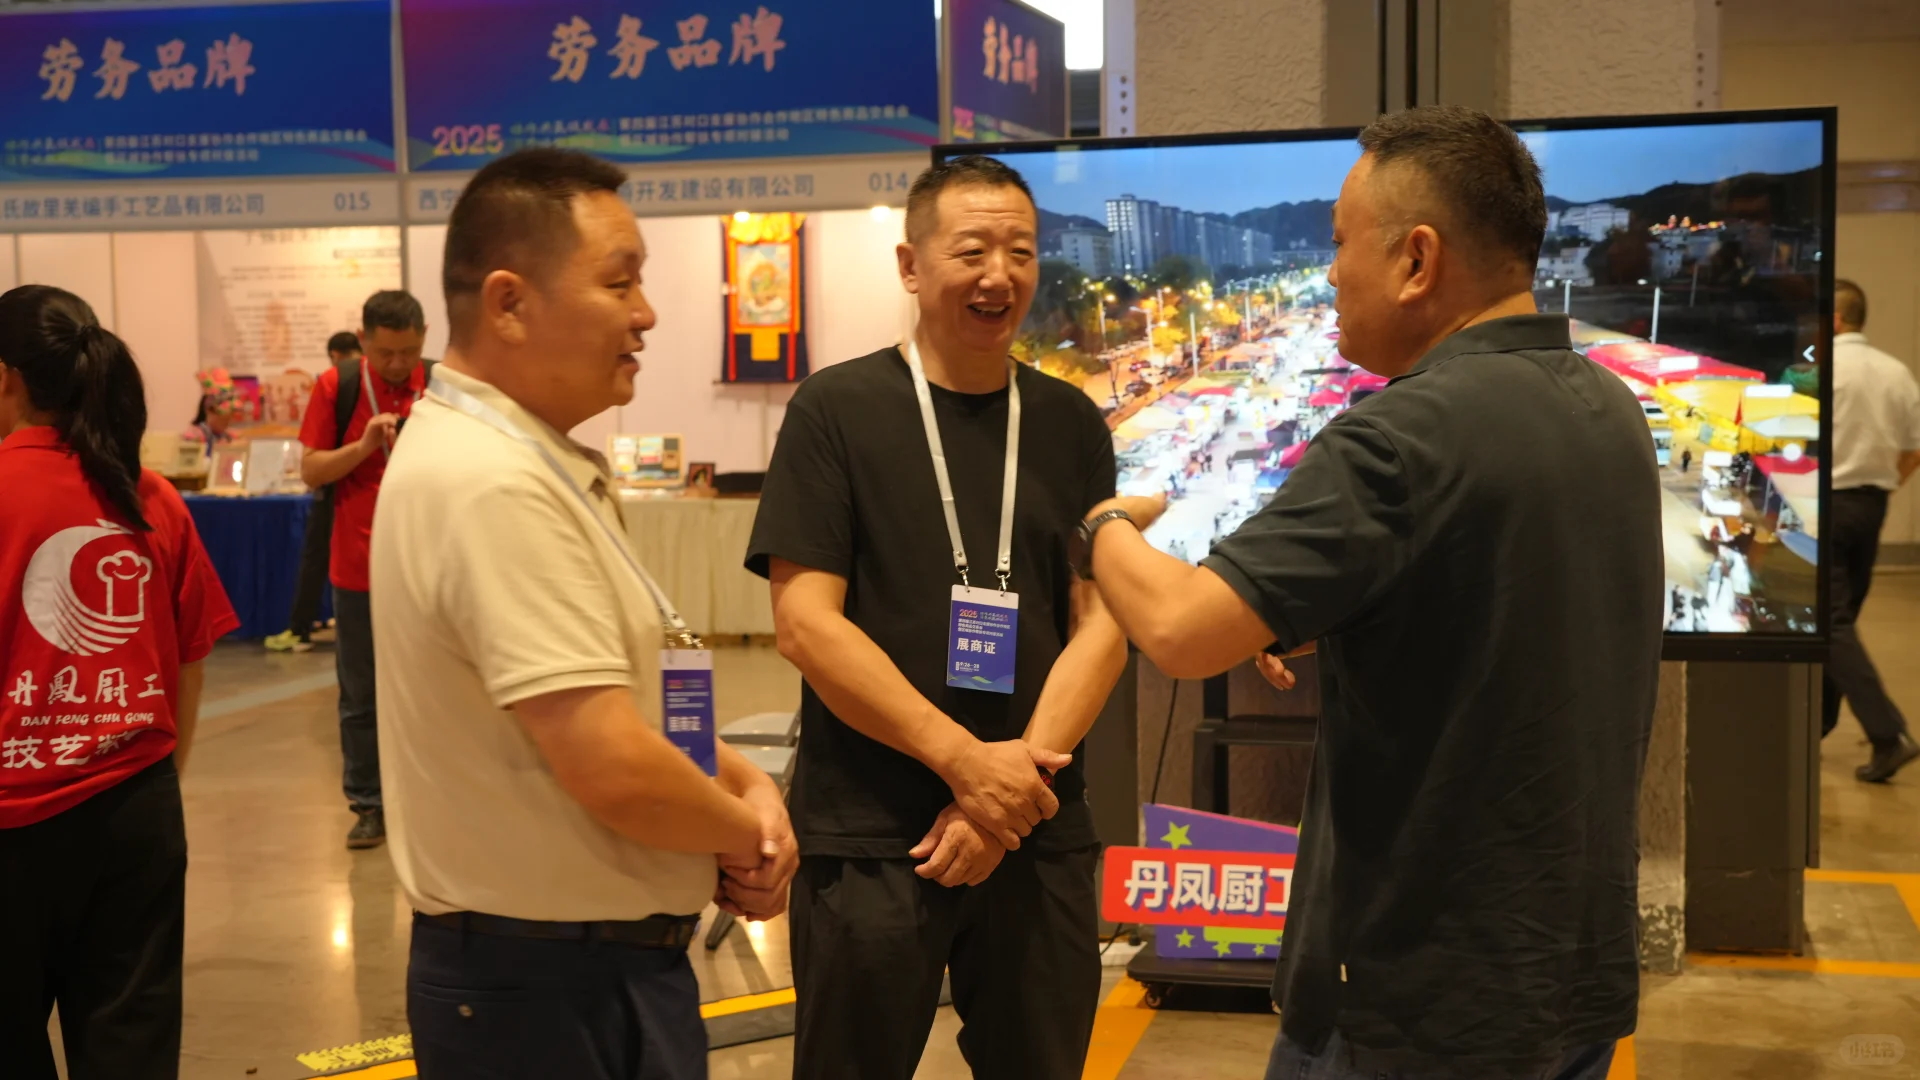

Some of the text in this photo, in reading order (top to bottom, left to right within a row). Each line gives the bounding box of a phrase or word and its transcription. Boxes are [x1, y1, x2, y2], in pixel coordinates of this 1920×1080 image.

[548, 6, 785, 83] 劳务品牌
[39, 32, 256, 102] 劳务品牌
[432, 124, 503, 156] 2025
[869, 172, 908, 193] 014
[334, 191, 371, 212] 015
[957, 638, 995, 654] 展商证
[20, 715, 51, 727] DAN
[124, 712, 154, 725] GONG
